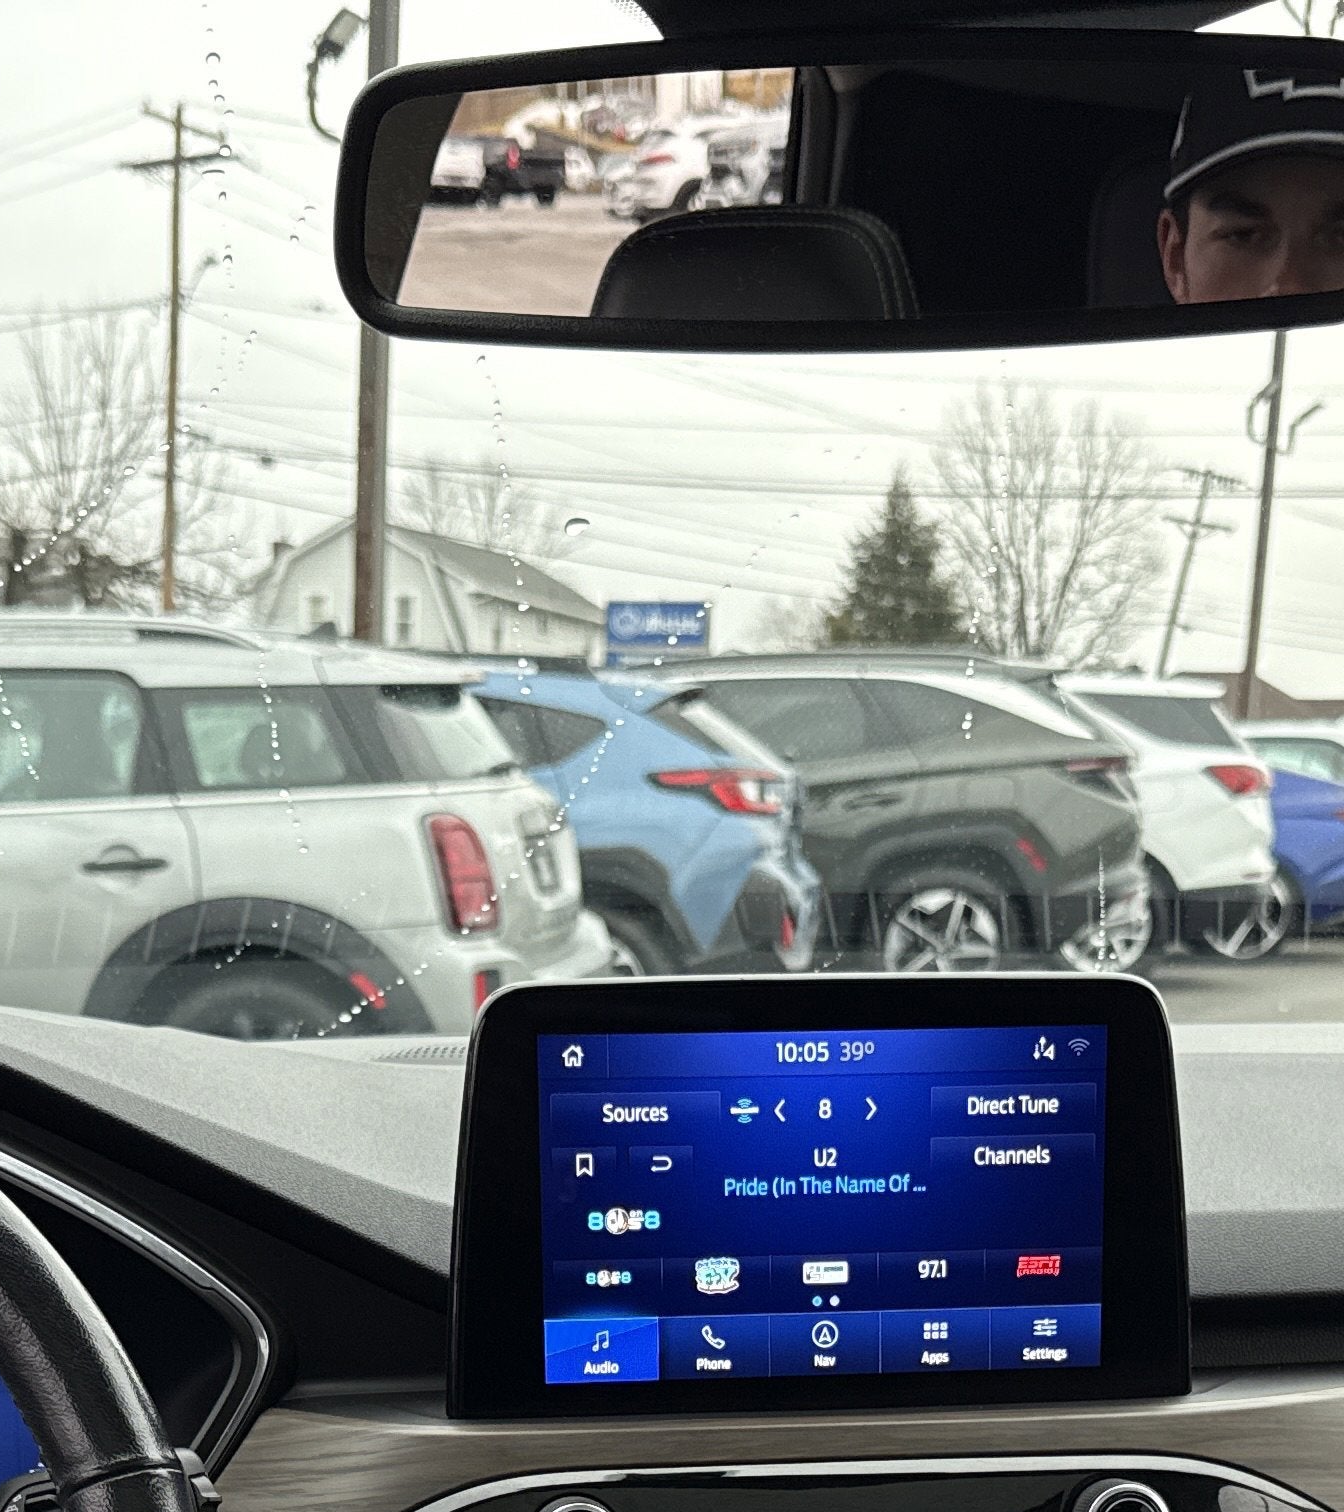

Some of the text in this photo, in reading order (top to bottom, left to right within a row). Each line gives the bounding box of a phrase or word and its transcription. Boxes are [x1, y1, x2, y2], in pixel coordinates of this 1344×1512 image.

[775, 1042, 829, 1063] 10:05
[602, 1103, 668, 1123] Sources
[818, 1100, 832, 1119] 8
[967, 1095, 1059, 1115] Direct Tune
[814, 1149, 837, 1166] U2
[974, 1146, 1050, 1166] Channels
[724, 1178, 768, 1197] Pride
[772, 1178, 797, 1200] (In
[800, 1177, 832, 1195] The
[836, 1176, 886, 1194] Name
[889, 1175, 910, 1193] Of
[919, 1259, 947, 1278] 97.1
[696, 1357, 731, 1371] Phone
[814, 1354, 836, 1368] Nav
[921, 1350, 949, 1367] Apps
[1022, 1346, 1068, 1363] Settings
[583, 1360, 619, 1376] Audio
